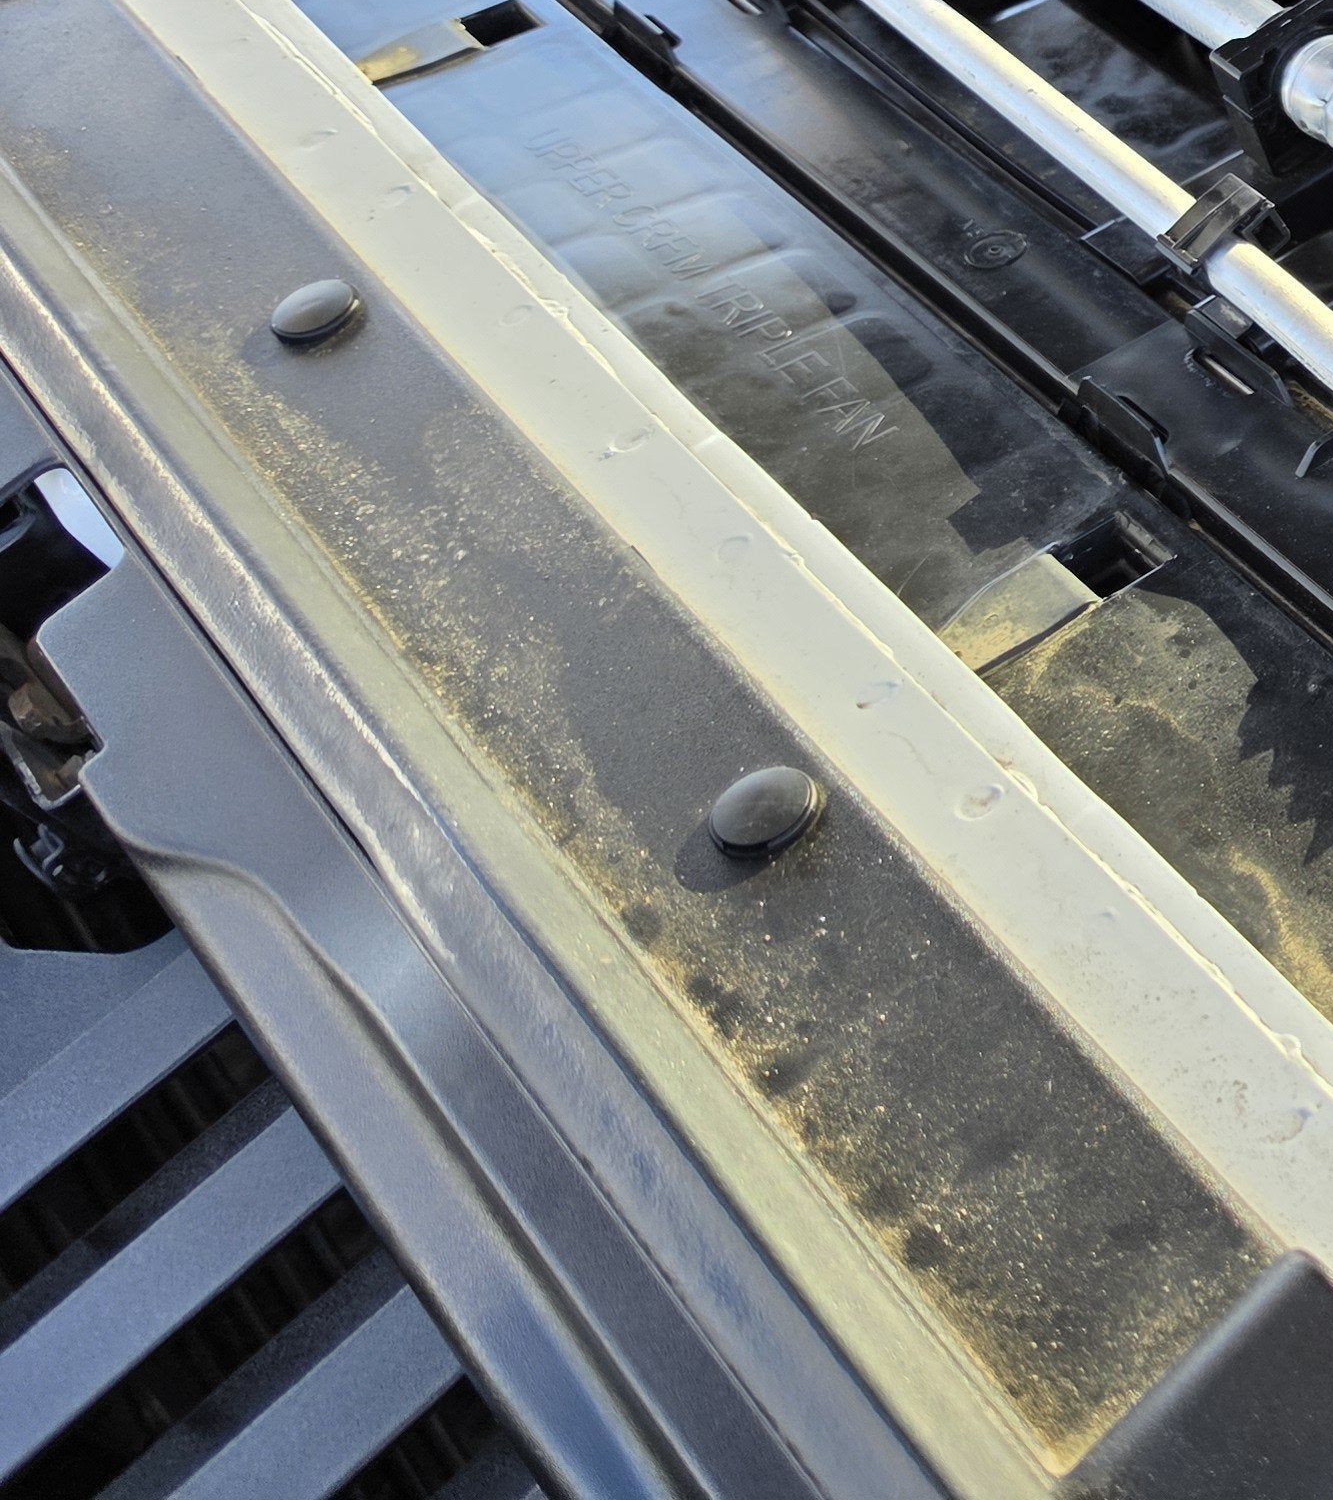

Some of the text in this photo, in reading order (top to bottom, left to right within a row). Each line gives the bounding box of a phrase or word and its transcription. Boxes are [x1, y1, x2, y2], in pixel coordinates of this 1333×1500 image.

[525, 127, 633, 212] UPPER
[694, 276, 830, 387] TRIPLE
[803, 366, 901, 452] FAN
